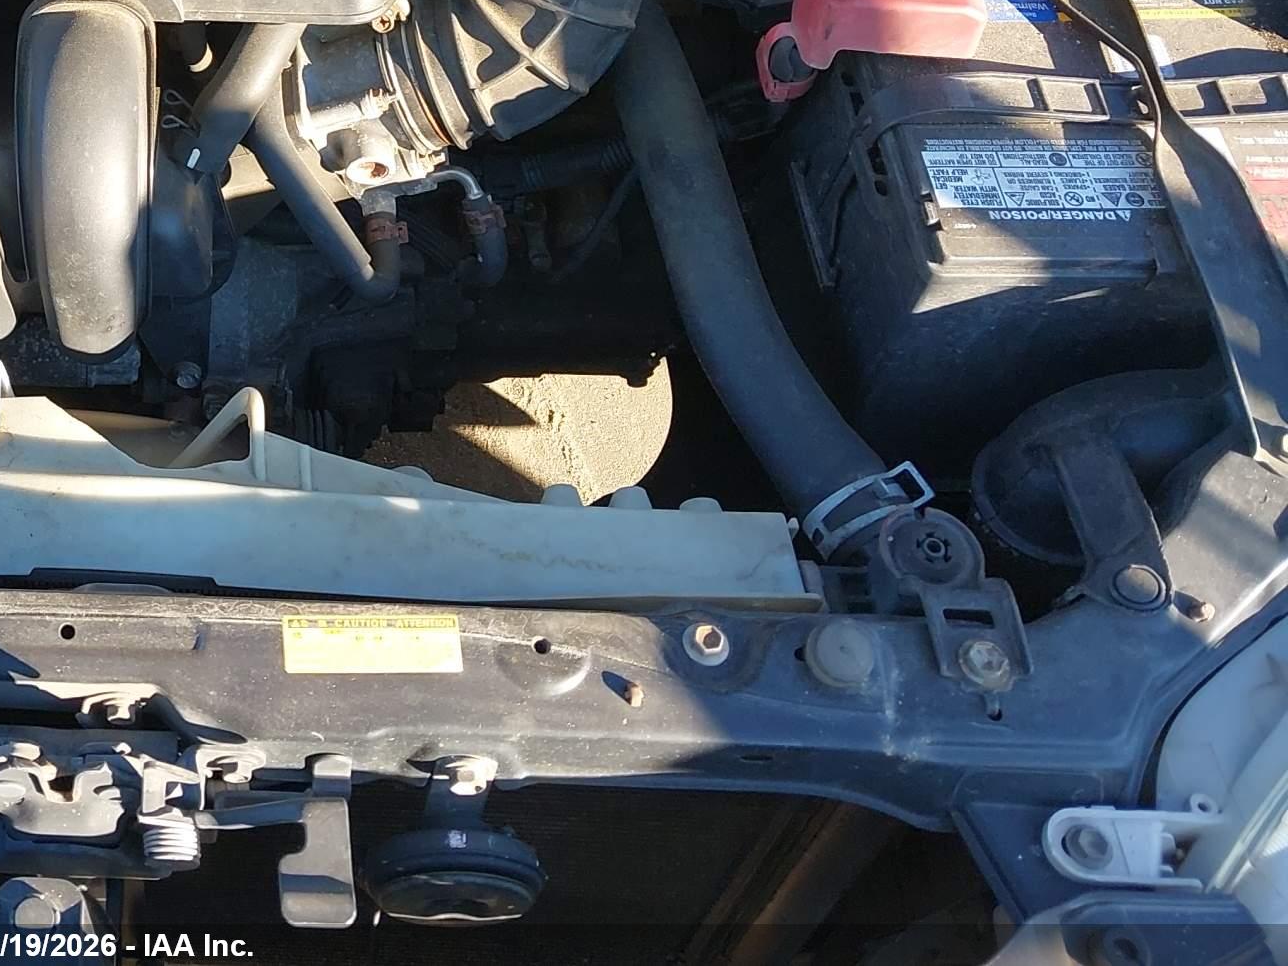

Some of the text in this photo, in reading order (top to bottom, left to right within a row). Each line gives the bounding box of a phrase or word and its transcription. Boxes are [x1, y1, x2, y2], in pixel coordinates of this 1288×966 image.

[988, 210, 1116, 220] DANGER/POISON
[335, 619, 388, 628] CAUTION
[396, 618, 455, 628] ATTENTION
